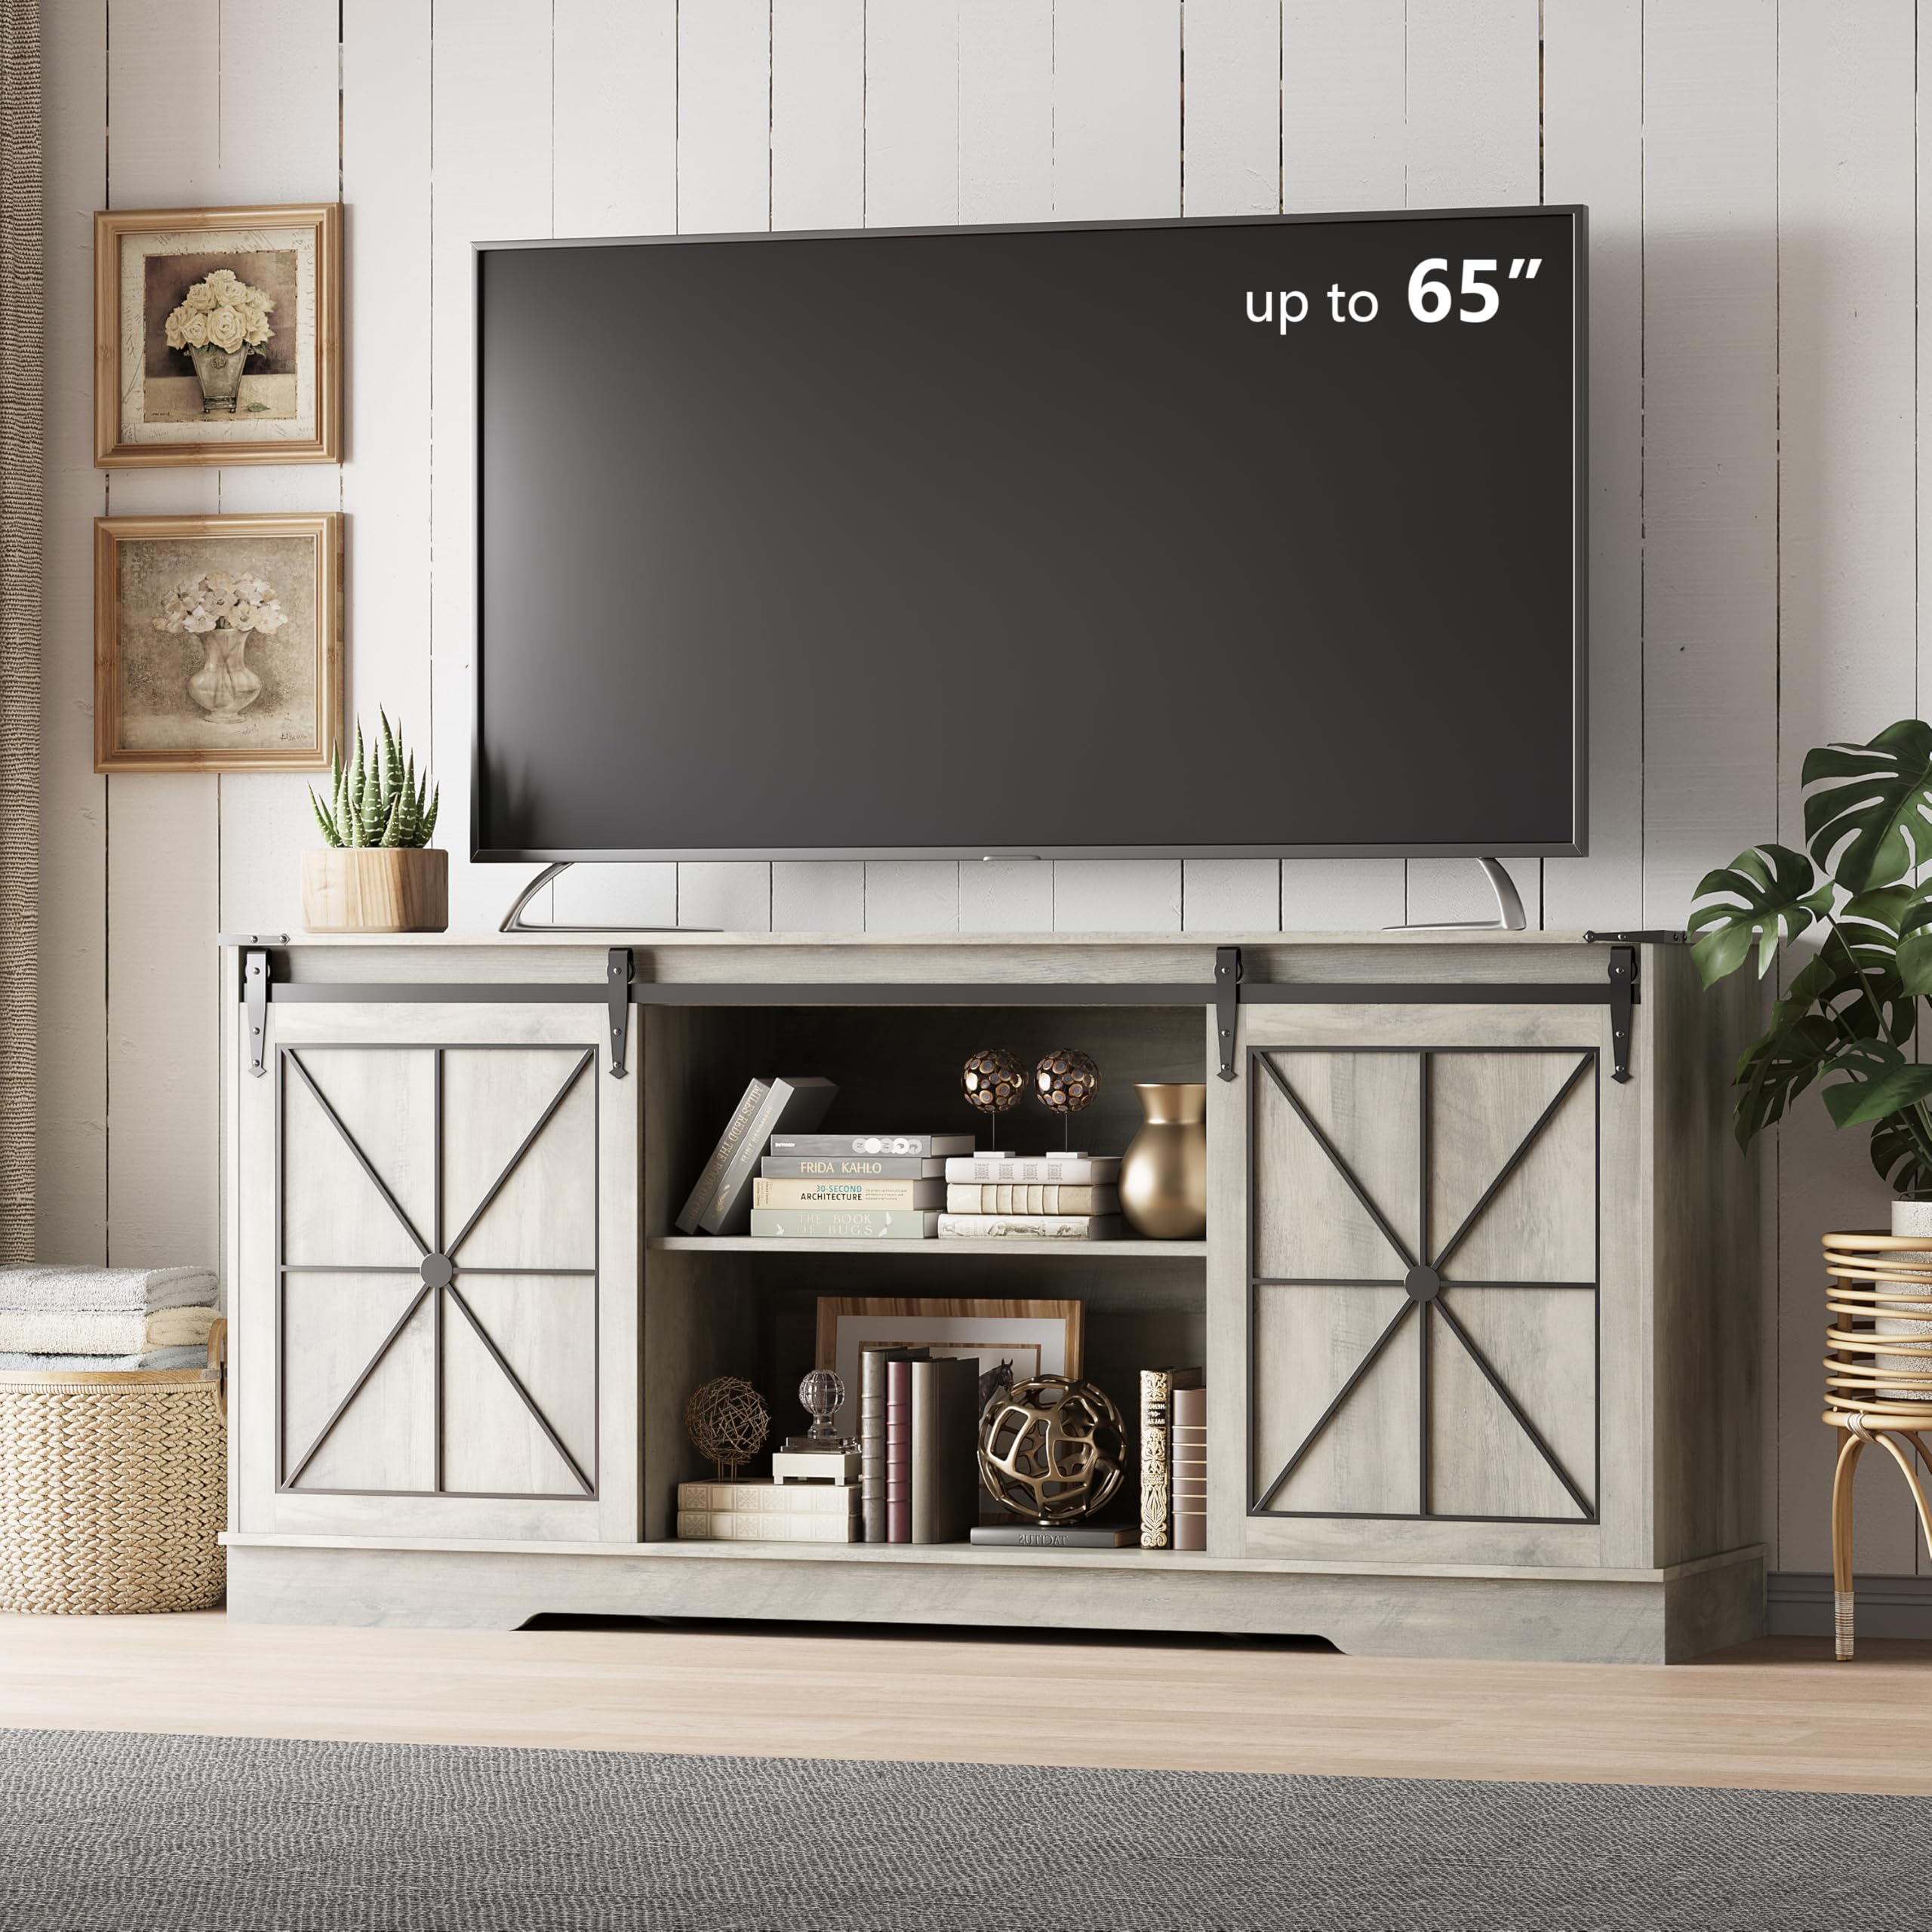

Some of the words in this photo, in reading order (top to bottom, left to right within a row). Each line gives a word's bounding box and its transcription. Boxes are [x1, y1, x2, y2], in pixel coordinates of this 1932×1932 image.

[742, 1084, 764, 1117] MILES
[728, 1114, 751, 1143] REDD
[801, 1161, 835, 1174] FRIDA
[841, 1161, 882, 1174] KAHLO
[816, 1185, 862, 1193] 30-SECOND
[801, 1192, 863, 1201] ARCHITECTURE
[797, 1212, 823, 1224] THE
[833, 1213, 872, 1225] BOOK
